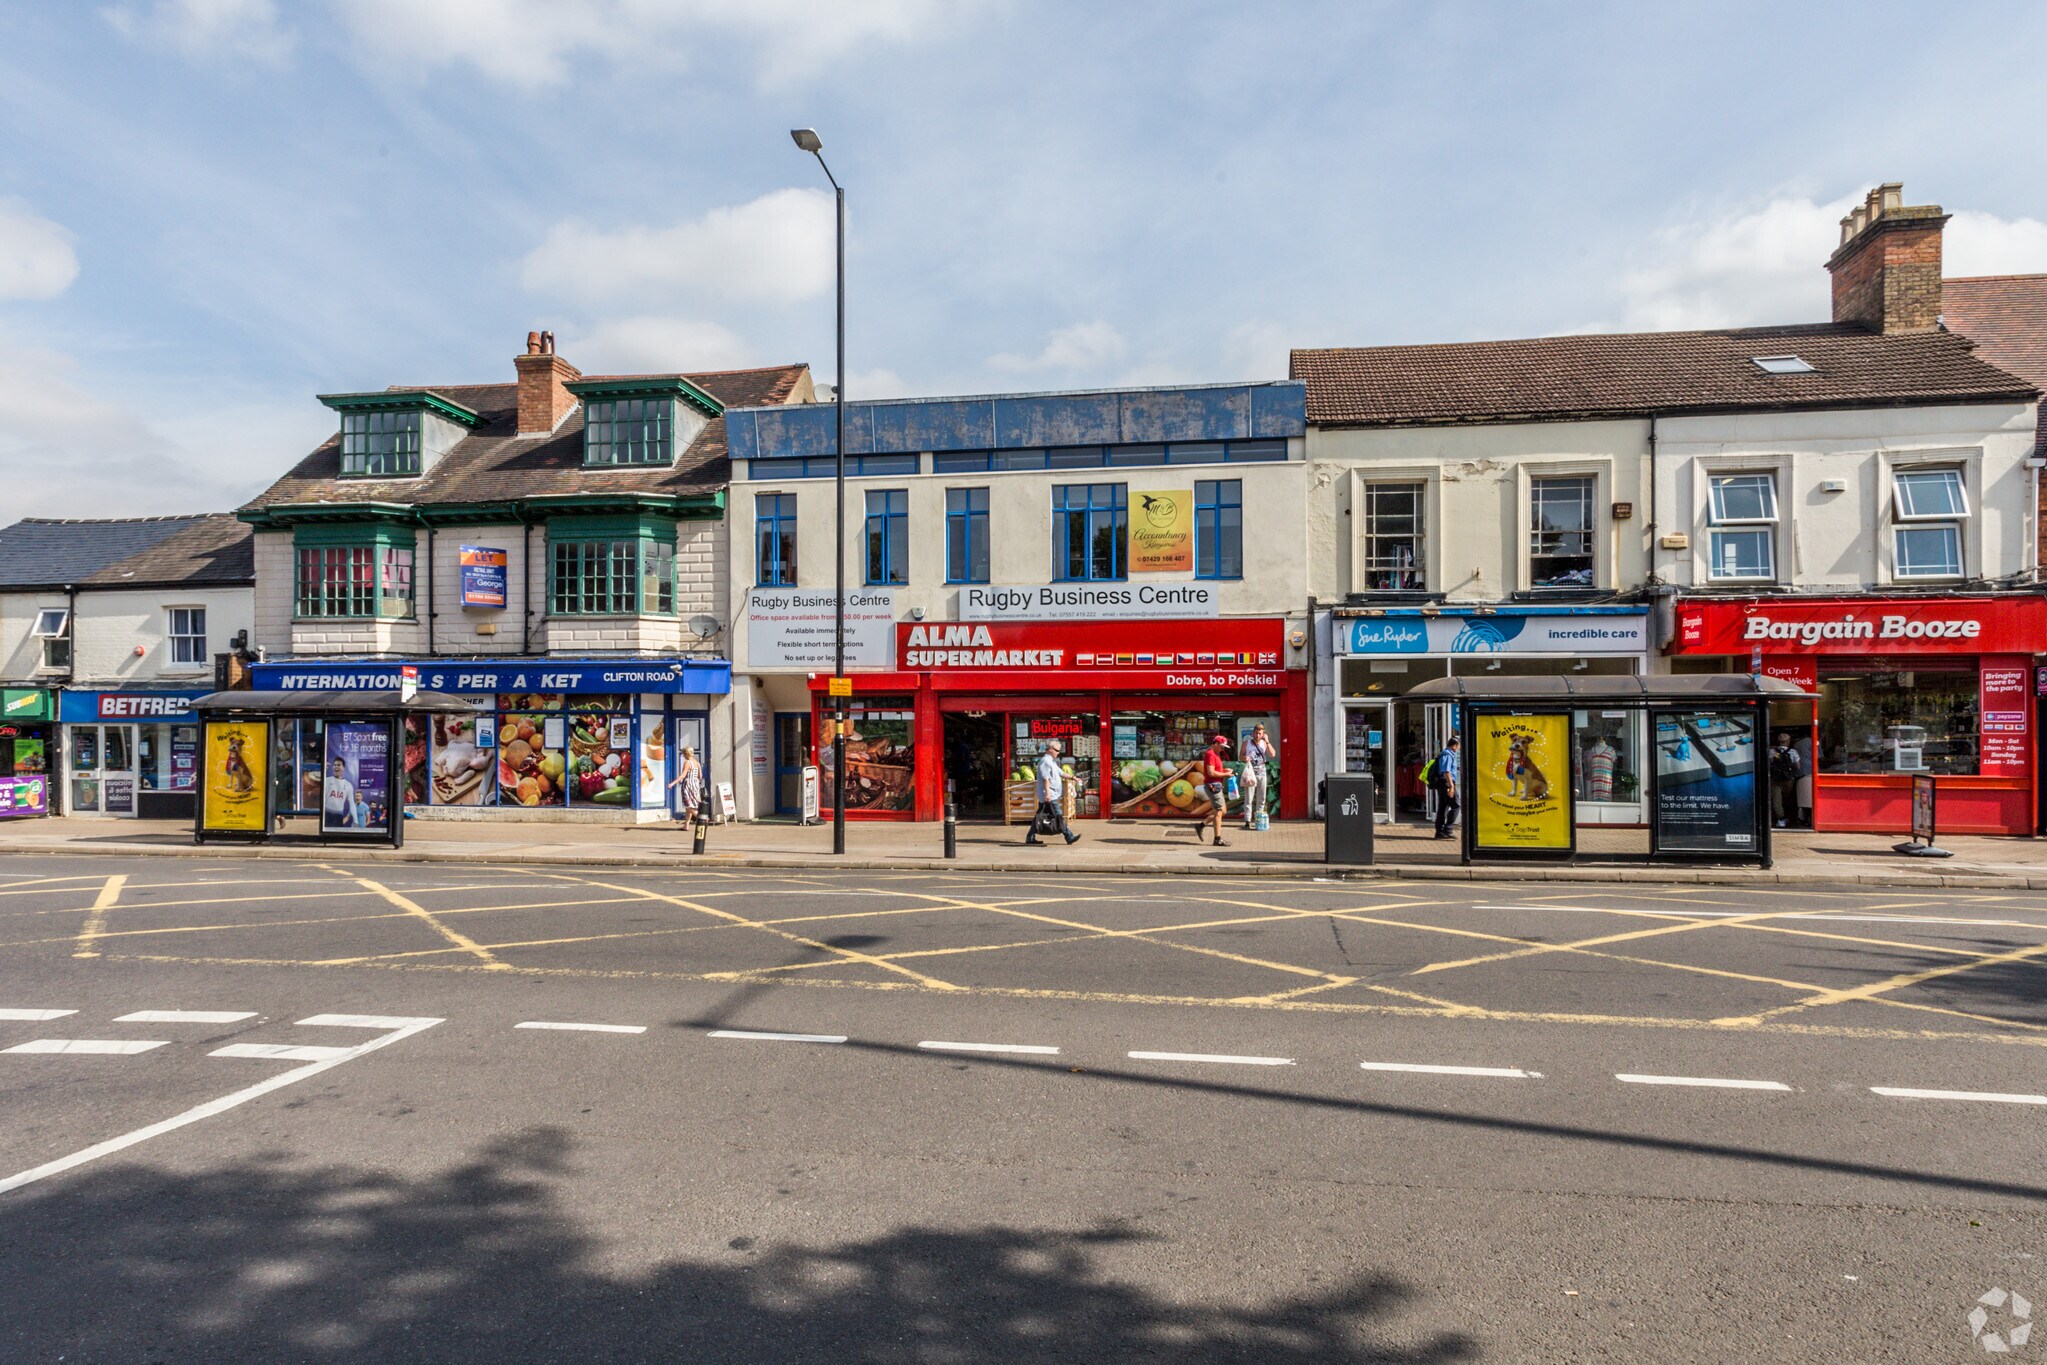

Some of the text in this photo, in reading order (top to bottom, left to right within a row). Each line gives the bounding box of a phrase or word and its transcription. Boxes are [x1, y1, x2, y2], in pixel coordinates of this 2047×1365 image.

[1134, 528, 1186, 542] Accountancy
[477, 578, 502, 588] George
[752, 596, 789, 610] Rugby
[850, 595, 890, 606] Centre
[970, 586, 1208, 610] Rugby Business Centre
[1682, 616, 1702, 628] Bargain
[907, 625, 993, 647] ALMA
[1548, 629, 1608, 638] incredible
[1685, 630, 1699, 640] Booze
[1744, 614, 1981, 645] Bargain Booze
[1358, 624, 1422, 649] Sue Ryder
[906, 649, 1064, 667] SUPERMARKET
[603, 672, 675, 682] CLIFTON ROAD
[1767, 667, 1792, 676] Open
[1166, 674, 1277, 686] Dobre, bo Polskie!
[6, 694, 38, 712] SUBWAY
[102, 698, 190, 715] BETFRED
[1033, 721, 1079, 736] Bulgaria
[343, 732, 387, 742] BT Sport free
[351, 743, 359, 752] 18
[330, 790, 344, 799] AIA
